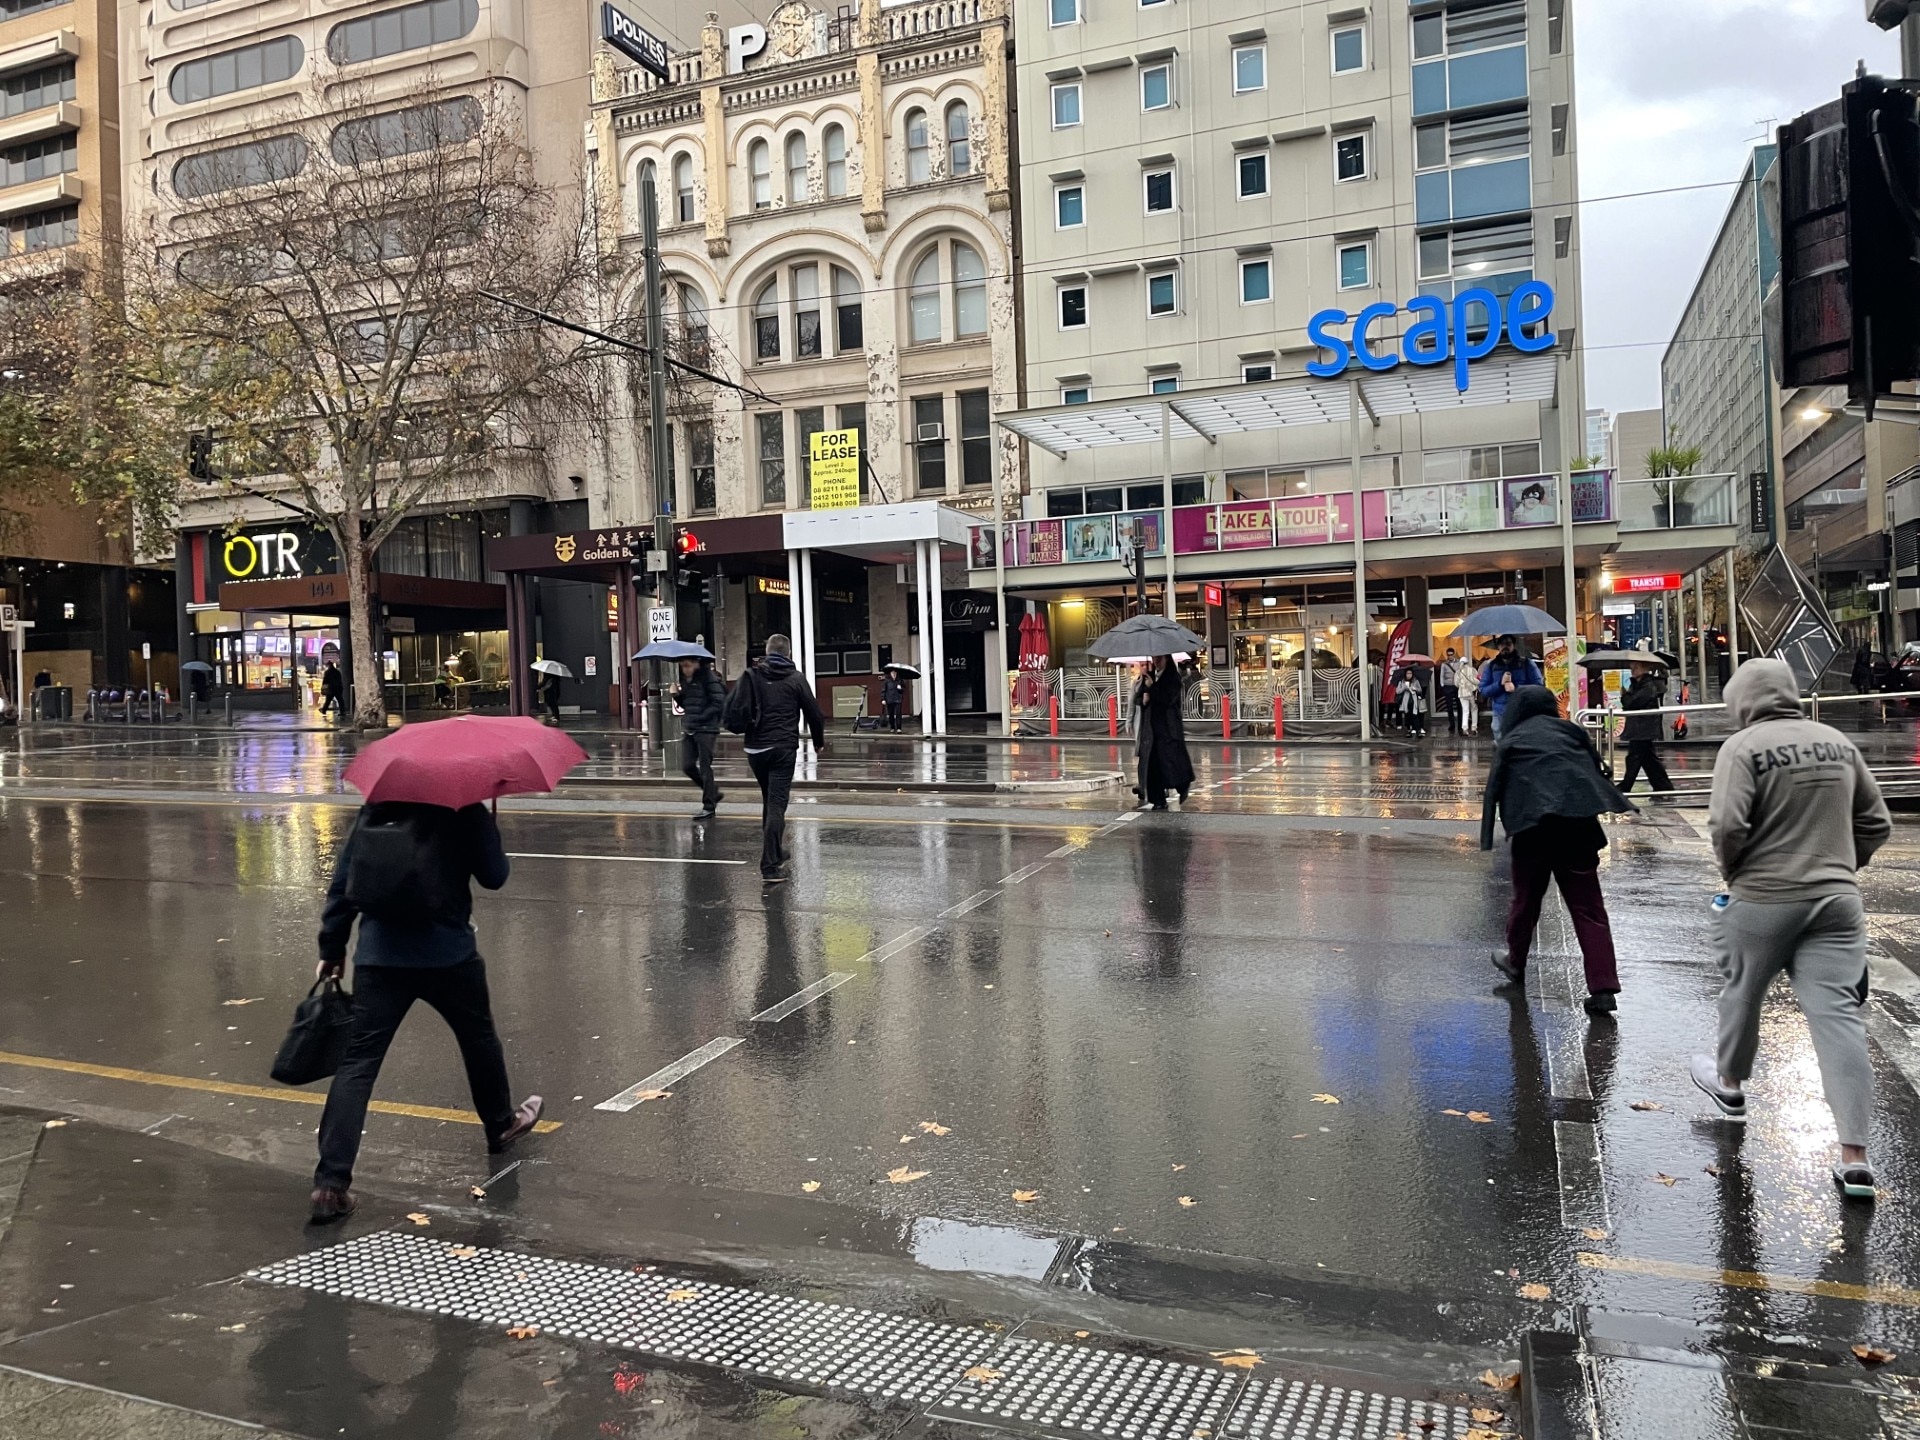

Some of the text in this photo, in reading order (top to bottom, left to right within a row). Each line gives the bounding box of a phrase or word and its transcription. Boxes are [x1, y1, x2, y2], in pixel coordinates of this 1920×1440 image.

[612, 9, 665, 67] POLITES
[728, 23, 767, 74] P
[1306, 280, 1556, 392] scape
[821, 433, 848, 447] FOR
[813, 446, 857, 462] LEASE
[1283, 509, 1327, 526] TOUR
[1051, 523, 1058, 532] A
[1031, 532, 1059, 543] PLACE
[1041, 542, 1059, 551] FOR
[224, 532, 302, 577] OTR
[583, 548, 620, 561] Golden
[950, 598, 991, 618] Firm
[652, 611, 670, 622] ONE
[651, 623, 672, 633] WAY
[949, 657, 967, 666] 142
